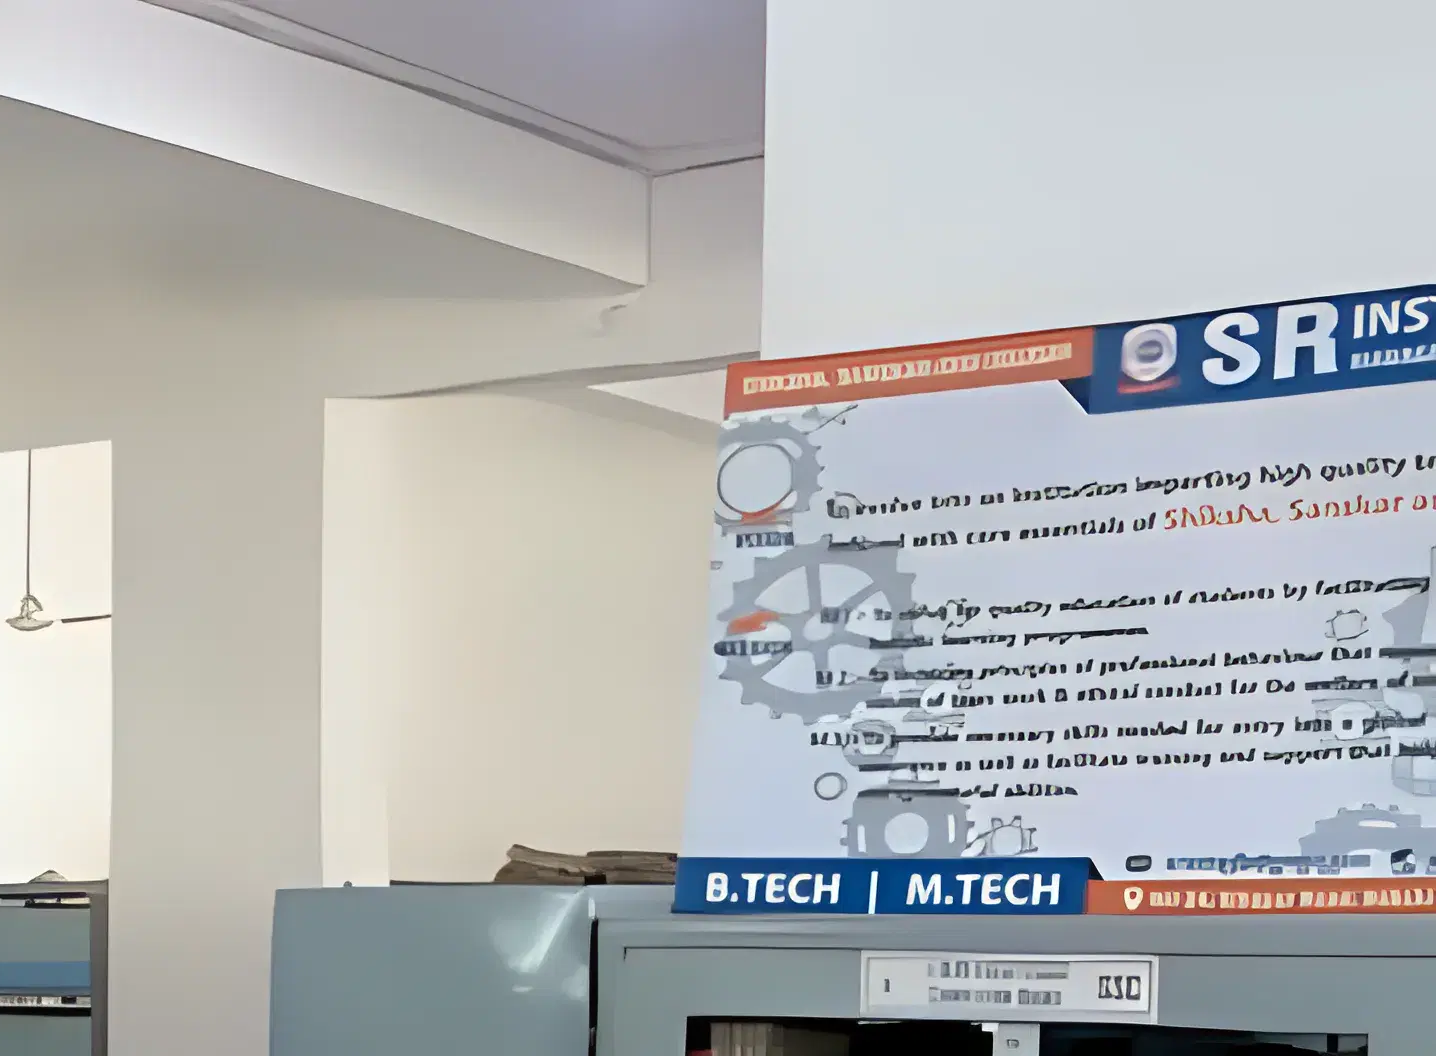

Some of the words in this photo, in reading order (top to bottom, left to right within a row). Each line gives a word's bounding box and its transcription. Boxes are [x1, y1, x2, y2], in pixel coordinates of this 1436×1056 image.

[1201, 301, 1340, 386] SR
[1353, 295, 1436, 339] INS
[704, 871, 842, 905] B.TECH
[905, 872, 1062, 906] M.TECH
